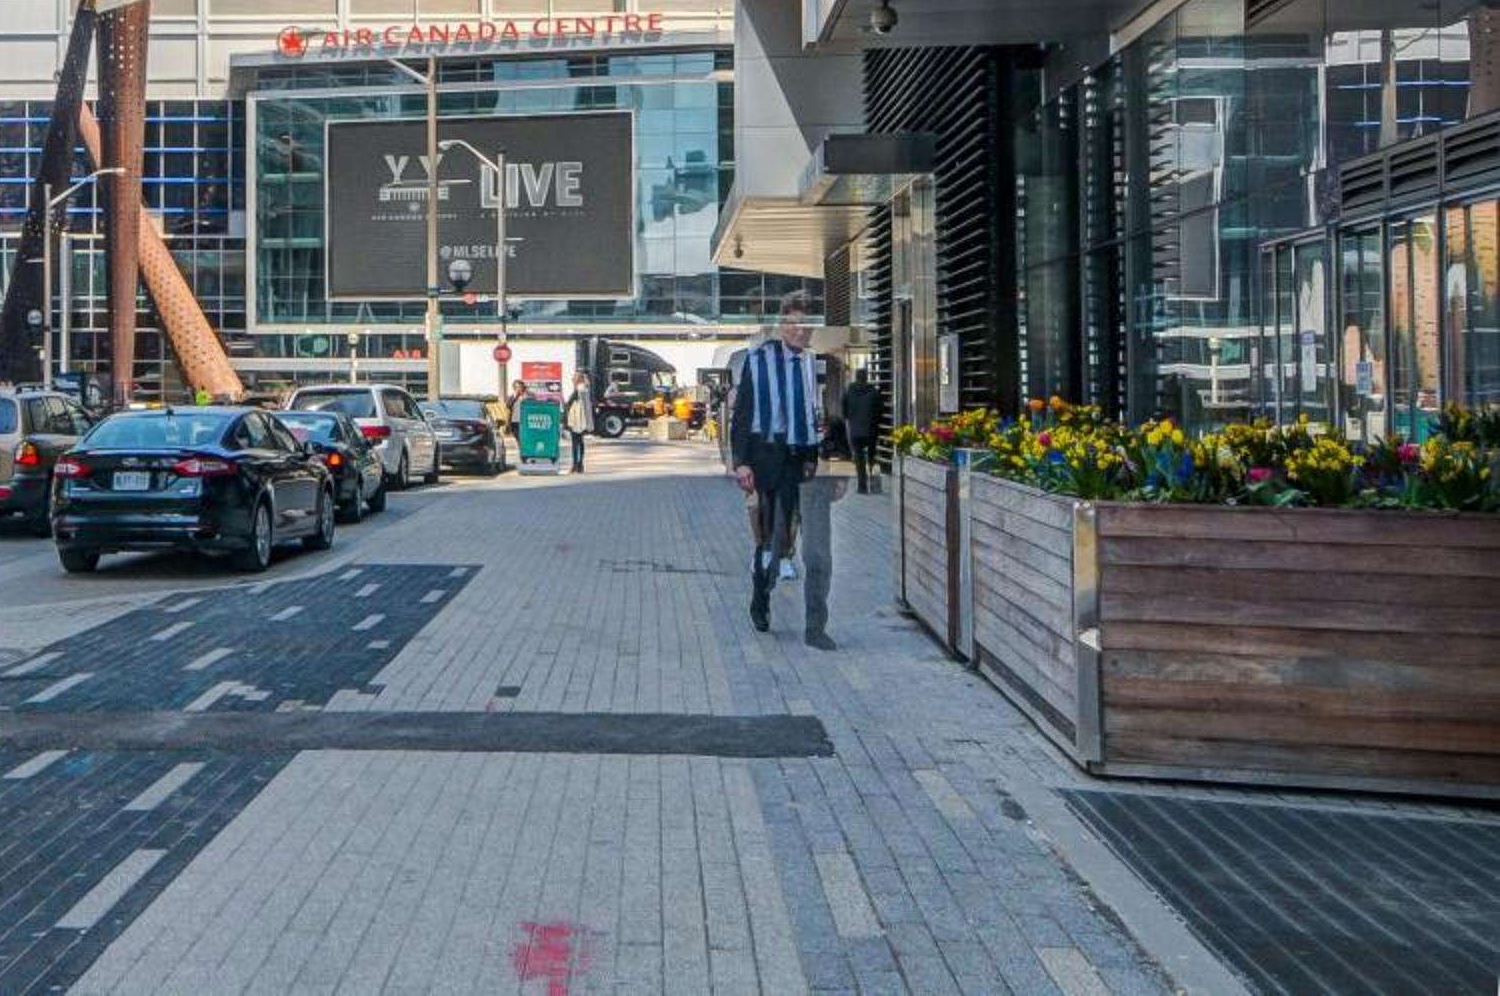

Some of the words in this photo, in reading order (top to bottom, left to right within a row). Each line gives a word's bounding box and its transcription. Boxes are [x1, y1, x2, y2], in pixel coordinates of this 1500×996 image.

[323, 28, 373, 47] AIR
[384, 22, 519, 47] CANADA
[533, 13, 663, 39] CENTRE
[480, 161, 584, 209] LIVE
